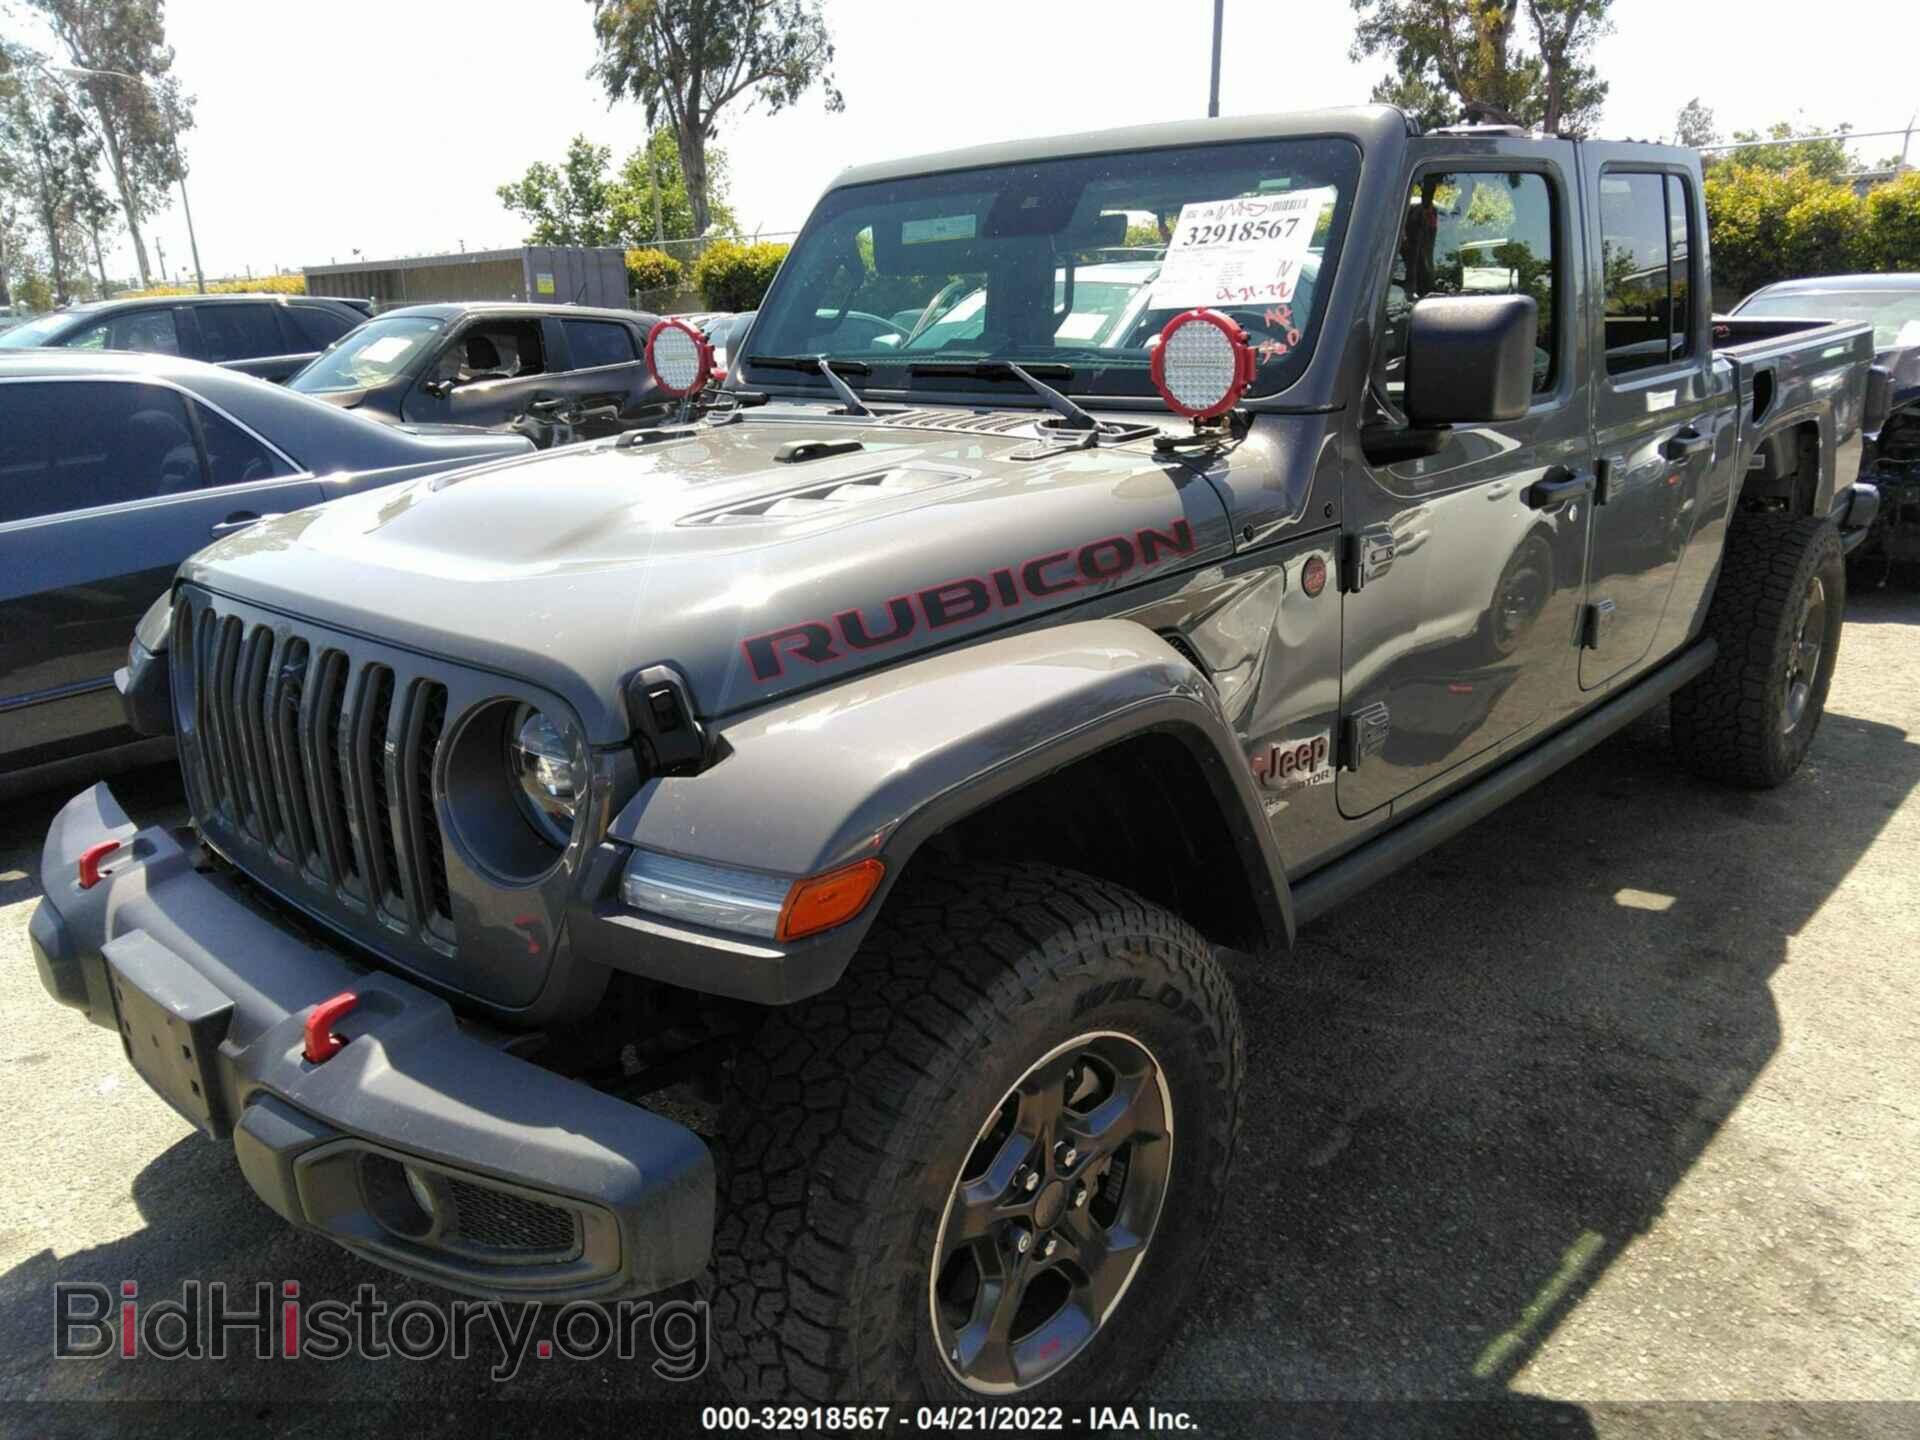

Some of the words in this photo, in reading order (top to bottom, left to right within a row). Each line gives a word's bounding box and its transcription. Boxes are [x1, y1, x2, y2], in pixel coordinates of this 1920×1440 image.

[1183, 217, 1300, 247] 32918567
[741, 516, 1199, 682] RUBICON
[1259, 736, 1329, 788] Jeep
